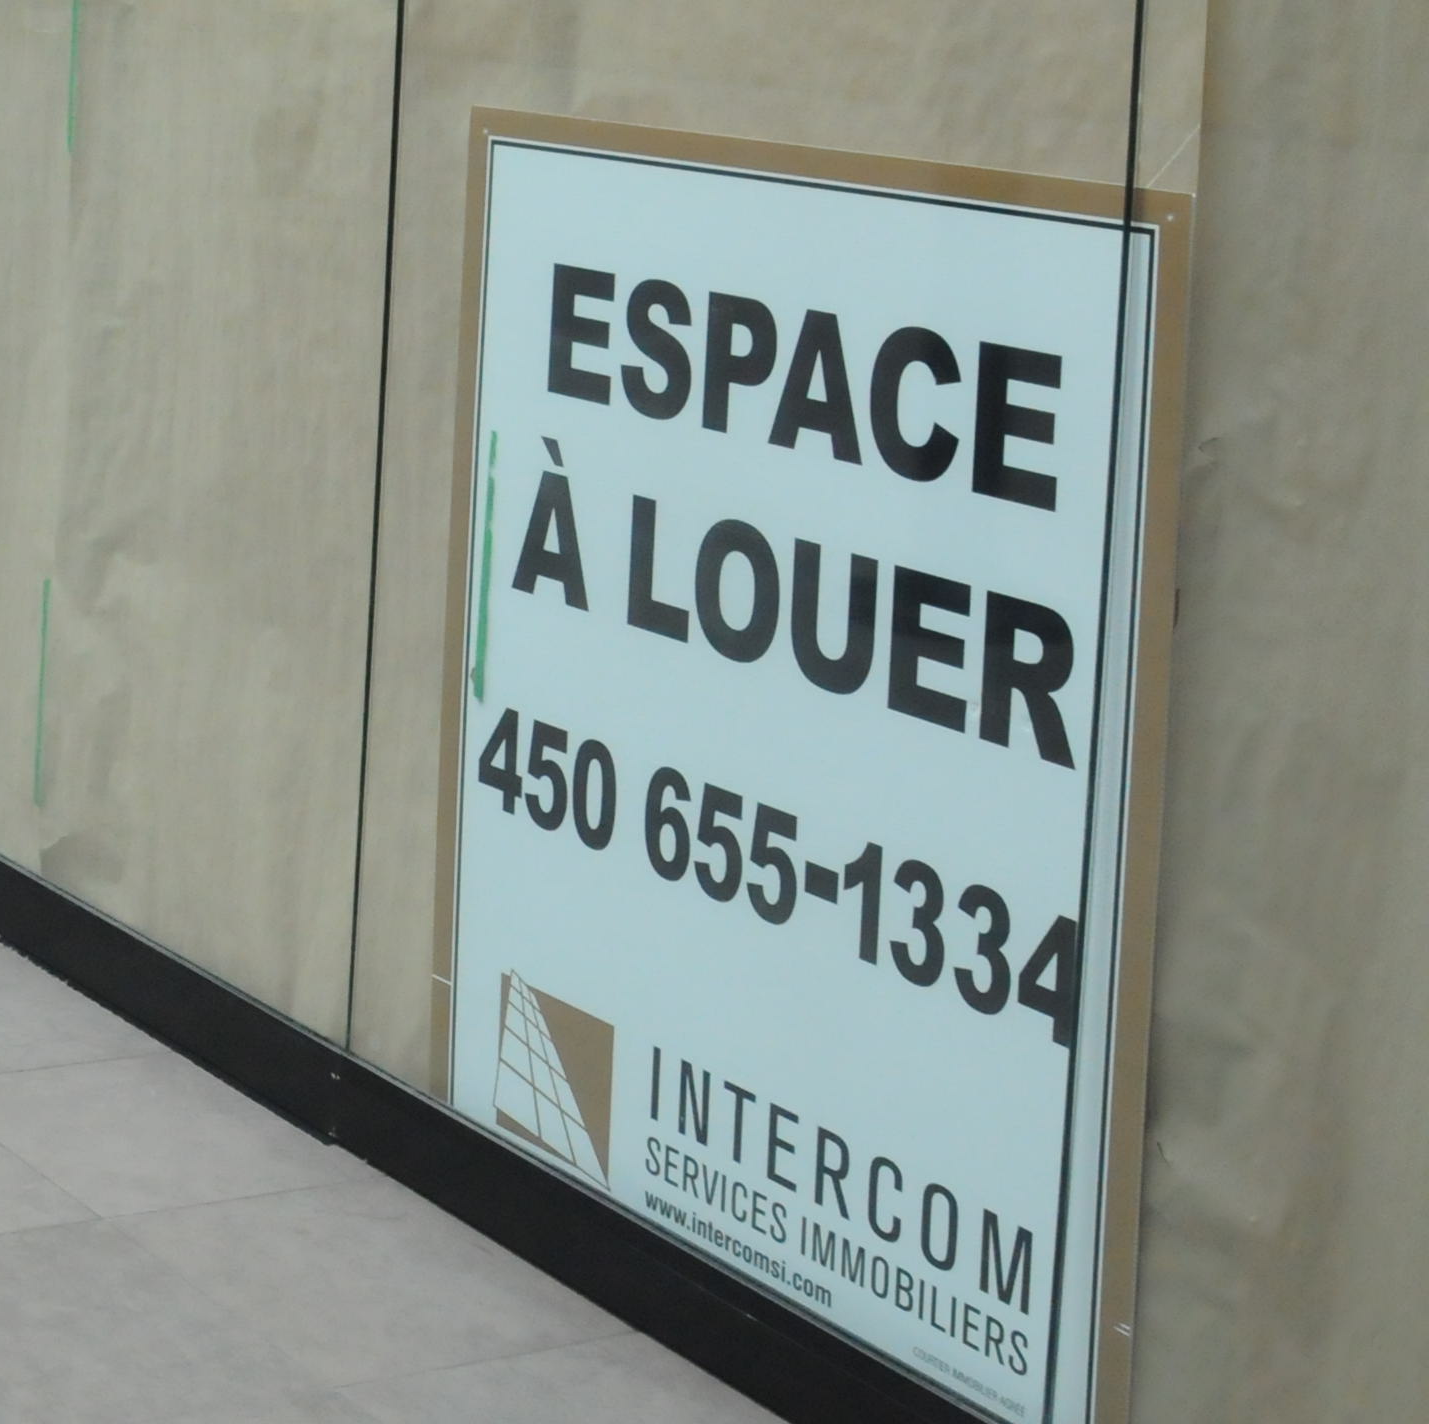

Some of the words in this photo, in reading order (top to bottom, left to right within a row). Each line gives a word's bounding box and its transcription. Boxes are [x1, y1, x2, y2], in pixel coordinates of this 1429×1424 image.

[547, 263, 1063, 513] ESPACE
[511, 436, 589, 612] À
[627, 494, 1076, 770] LOUER
[478, 707, 617, 851] 450
[644, 766, 1079, 1050] 655-1334
[645, 1190, 832, 1308] www.intercomsi.com
[645, 1136, 787, 1245] SERVICES
[801, 1216, 1029, 1377] IMMOBILIERS
[650, 1046, 1033, 1316] INTERCOM
